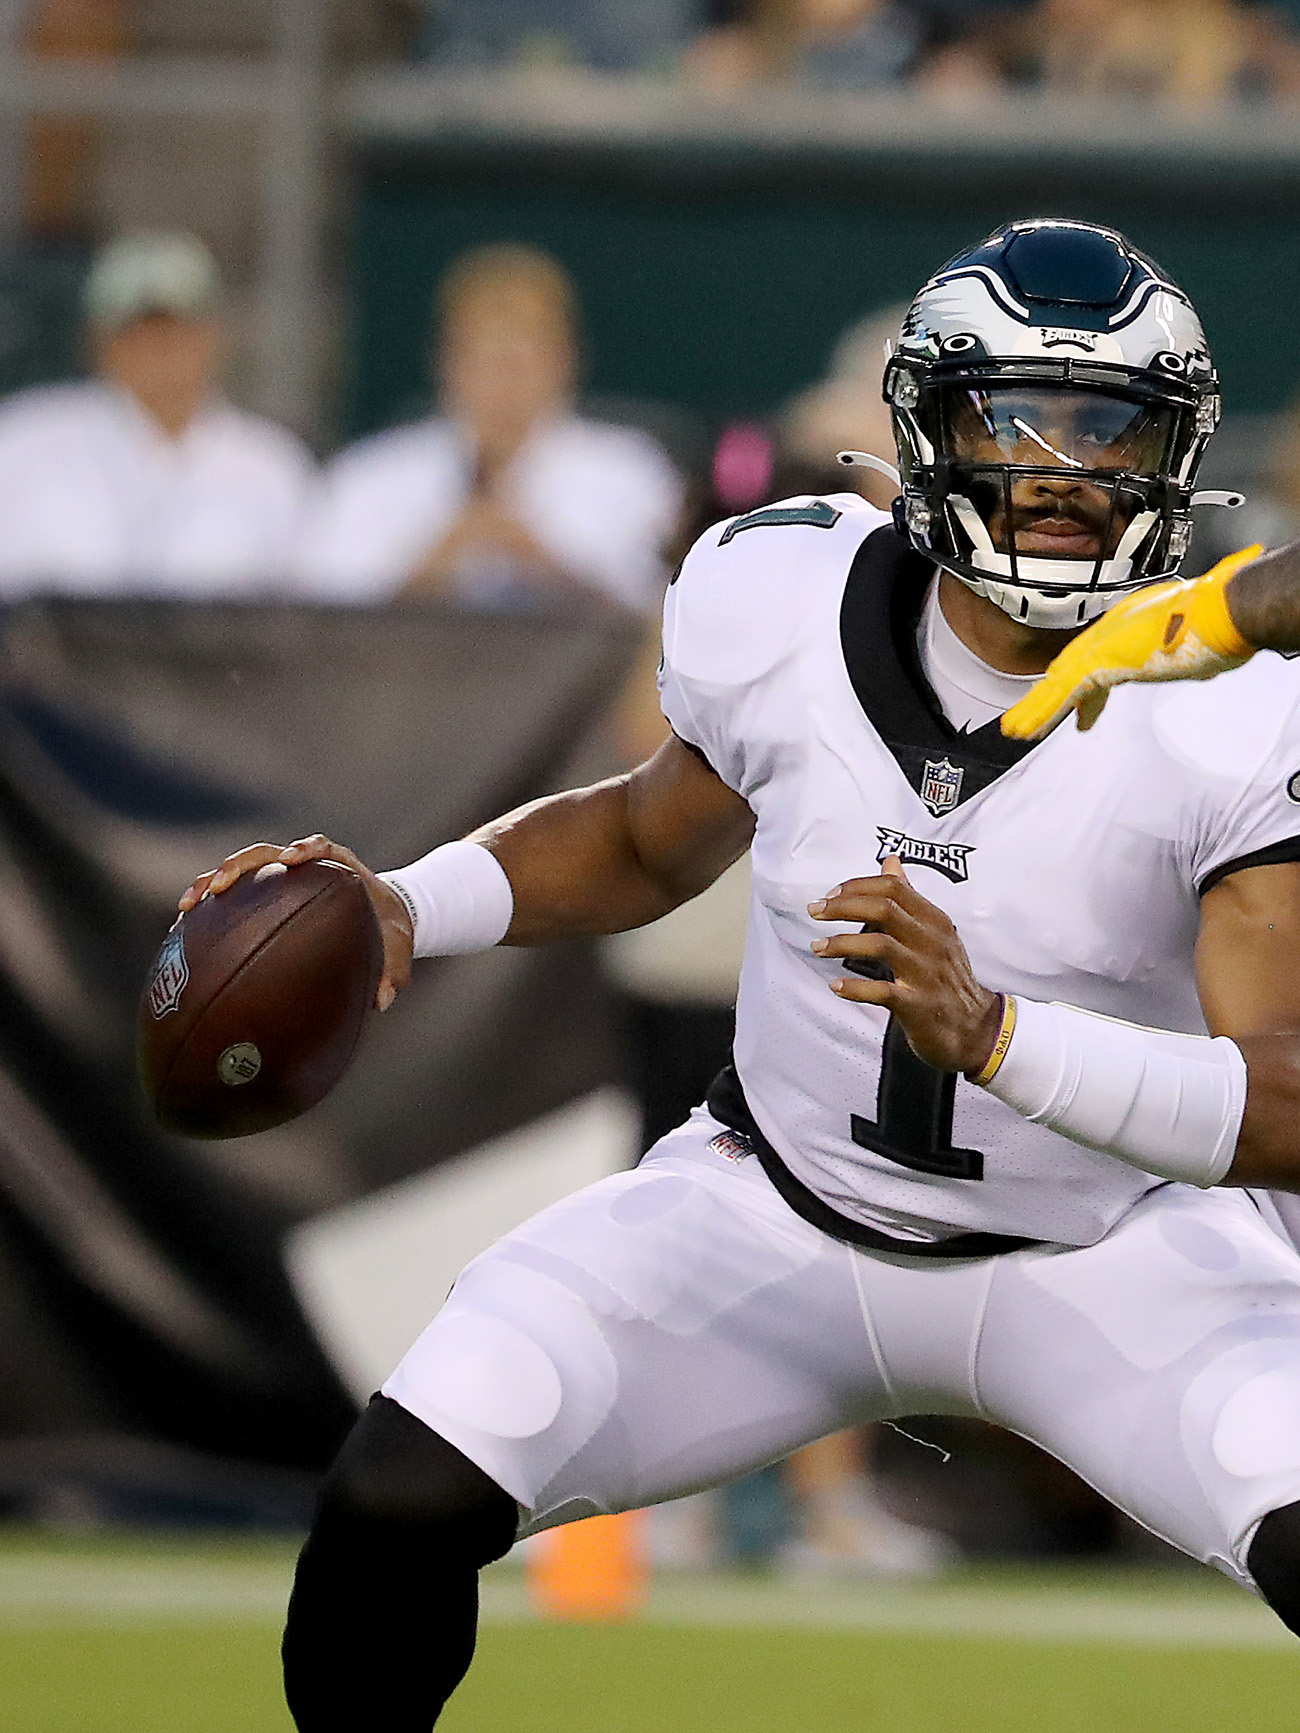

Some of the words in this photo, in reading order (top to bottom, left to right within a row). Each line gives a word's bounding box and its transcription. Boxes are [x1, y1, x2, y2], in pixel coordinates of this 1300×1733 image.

[926, 780, 953, 804] NFL
[875, 825, 978, 884] EAGLES
[151, 960, 184, 1011] NFL
[712, 1135, 743, 1160] NFL
